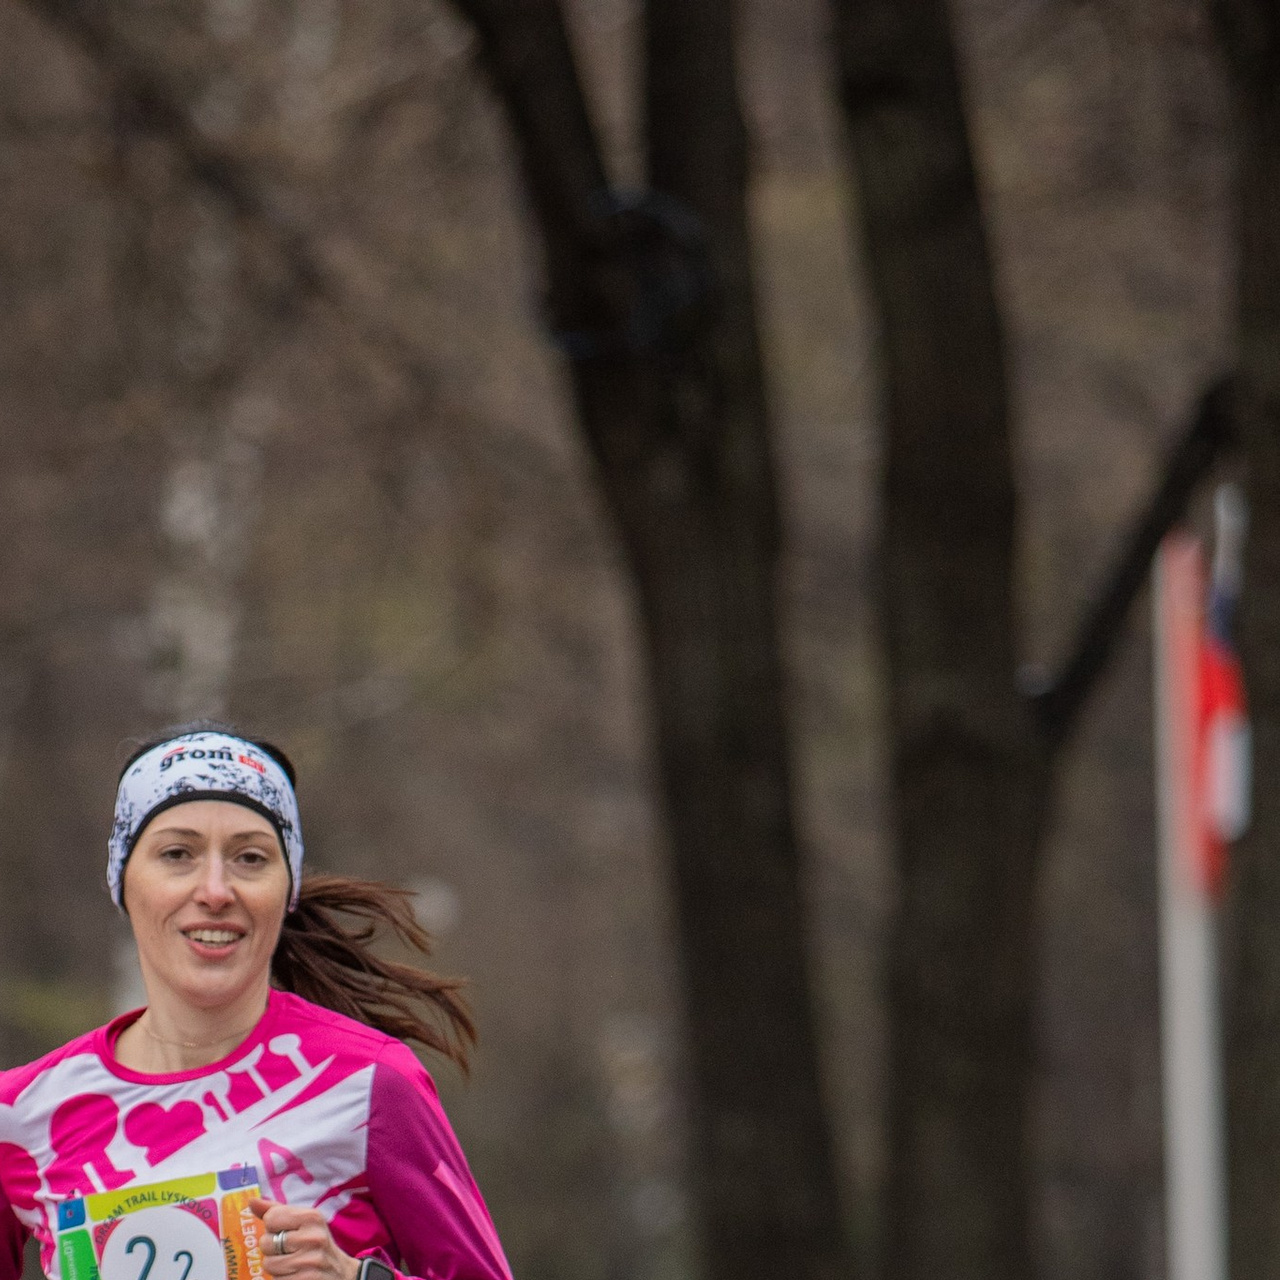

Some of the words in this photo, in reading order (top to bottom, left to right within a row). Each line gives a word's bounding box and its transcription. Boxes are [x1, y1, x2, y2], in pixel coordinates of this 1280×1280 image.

[160, 748, 234, 771] grom
[95, 1205, 125, 1245] DREAM
[124, 1191, 157, 1209] TRAIL
[161, 1191, 212, 1219] LYSKOVO
